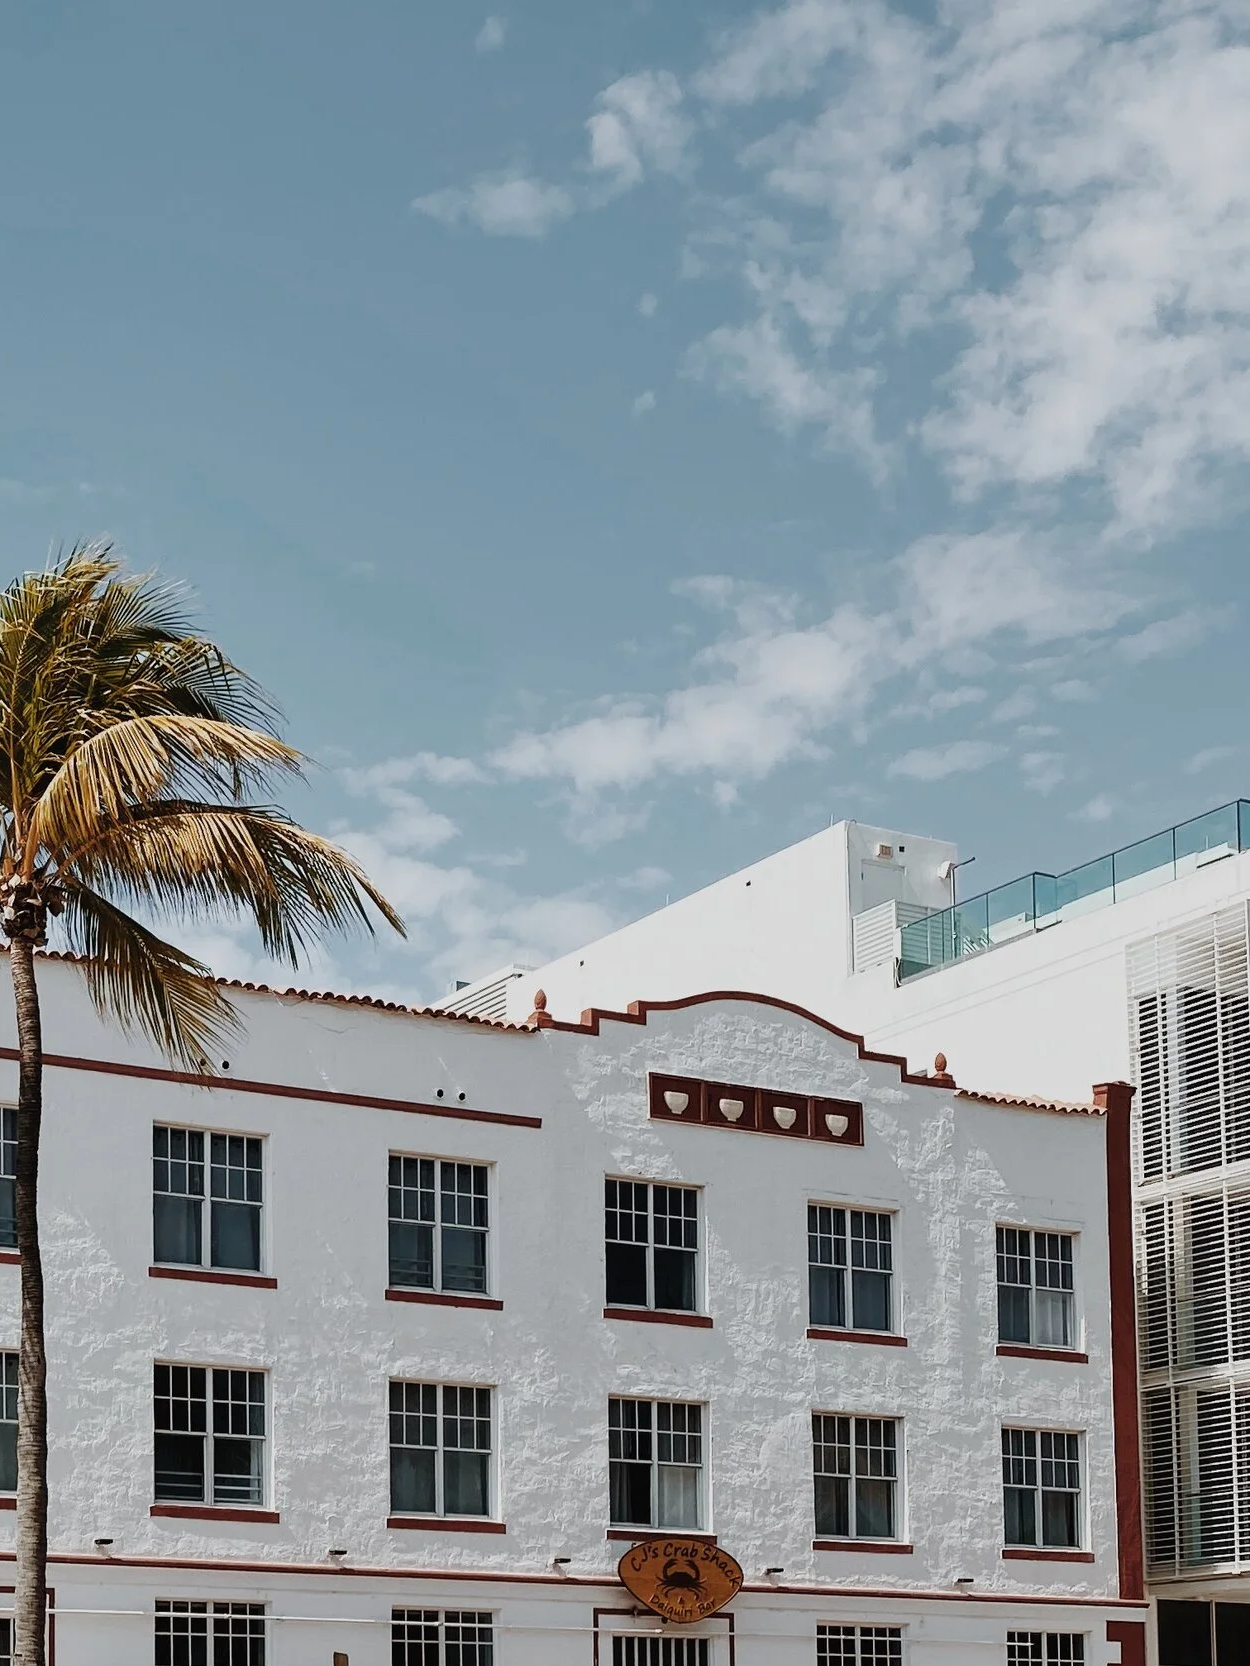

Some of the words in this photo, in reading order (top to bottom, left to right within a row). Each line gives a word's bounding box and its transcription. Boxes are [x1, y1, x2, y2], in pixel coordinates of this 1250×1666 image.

[663, 1542, 698, 1558] Crab
[701, 1545, 742, 1589] Shack
[649, 1594, 693, 1617] Daiquiri
[698, 1598, 716, 1615] Bar
